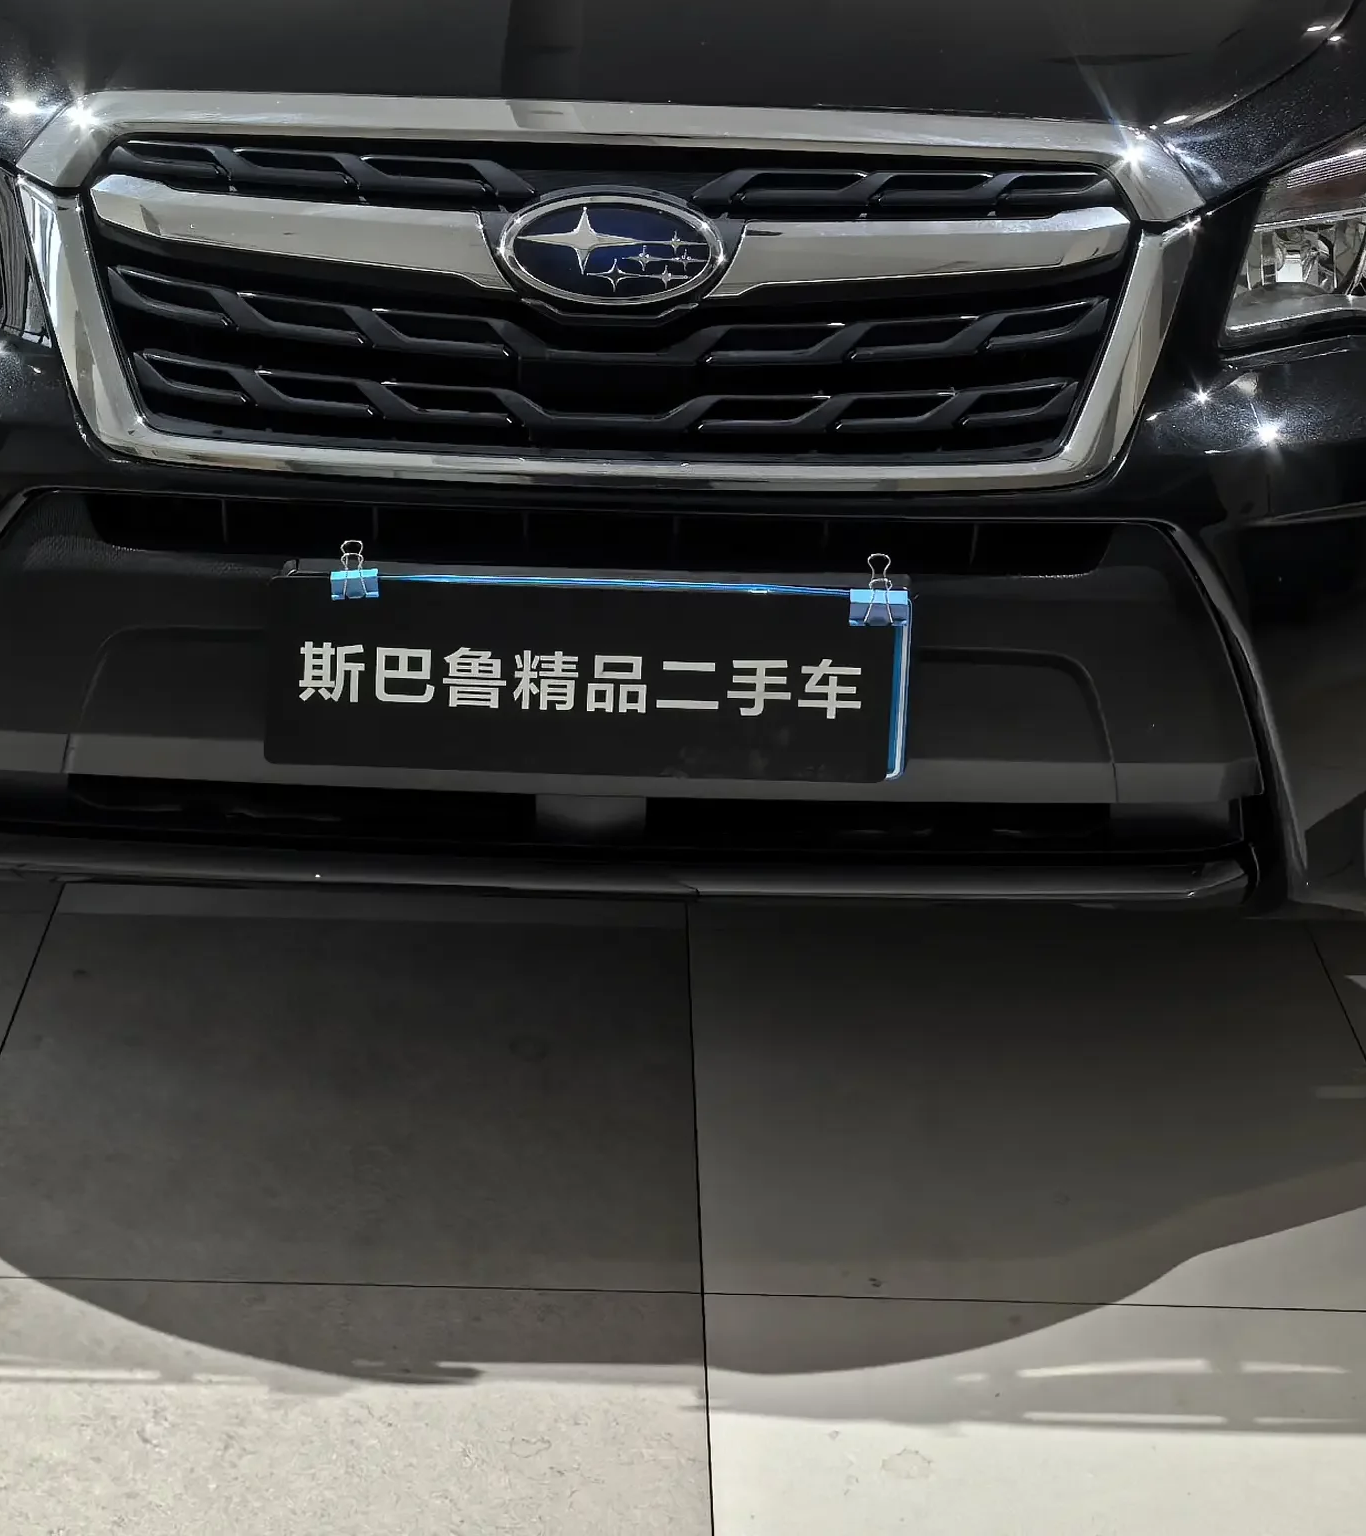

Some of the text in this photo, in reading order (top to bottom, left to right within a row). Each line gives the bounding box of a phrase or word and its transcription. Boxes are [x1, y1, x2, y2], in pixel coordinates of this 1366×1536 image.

[297, 640, 863, 720] 斯巴鲁精品二手车
